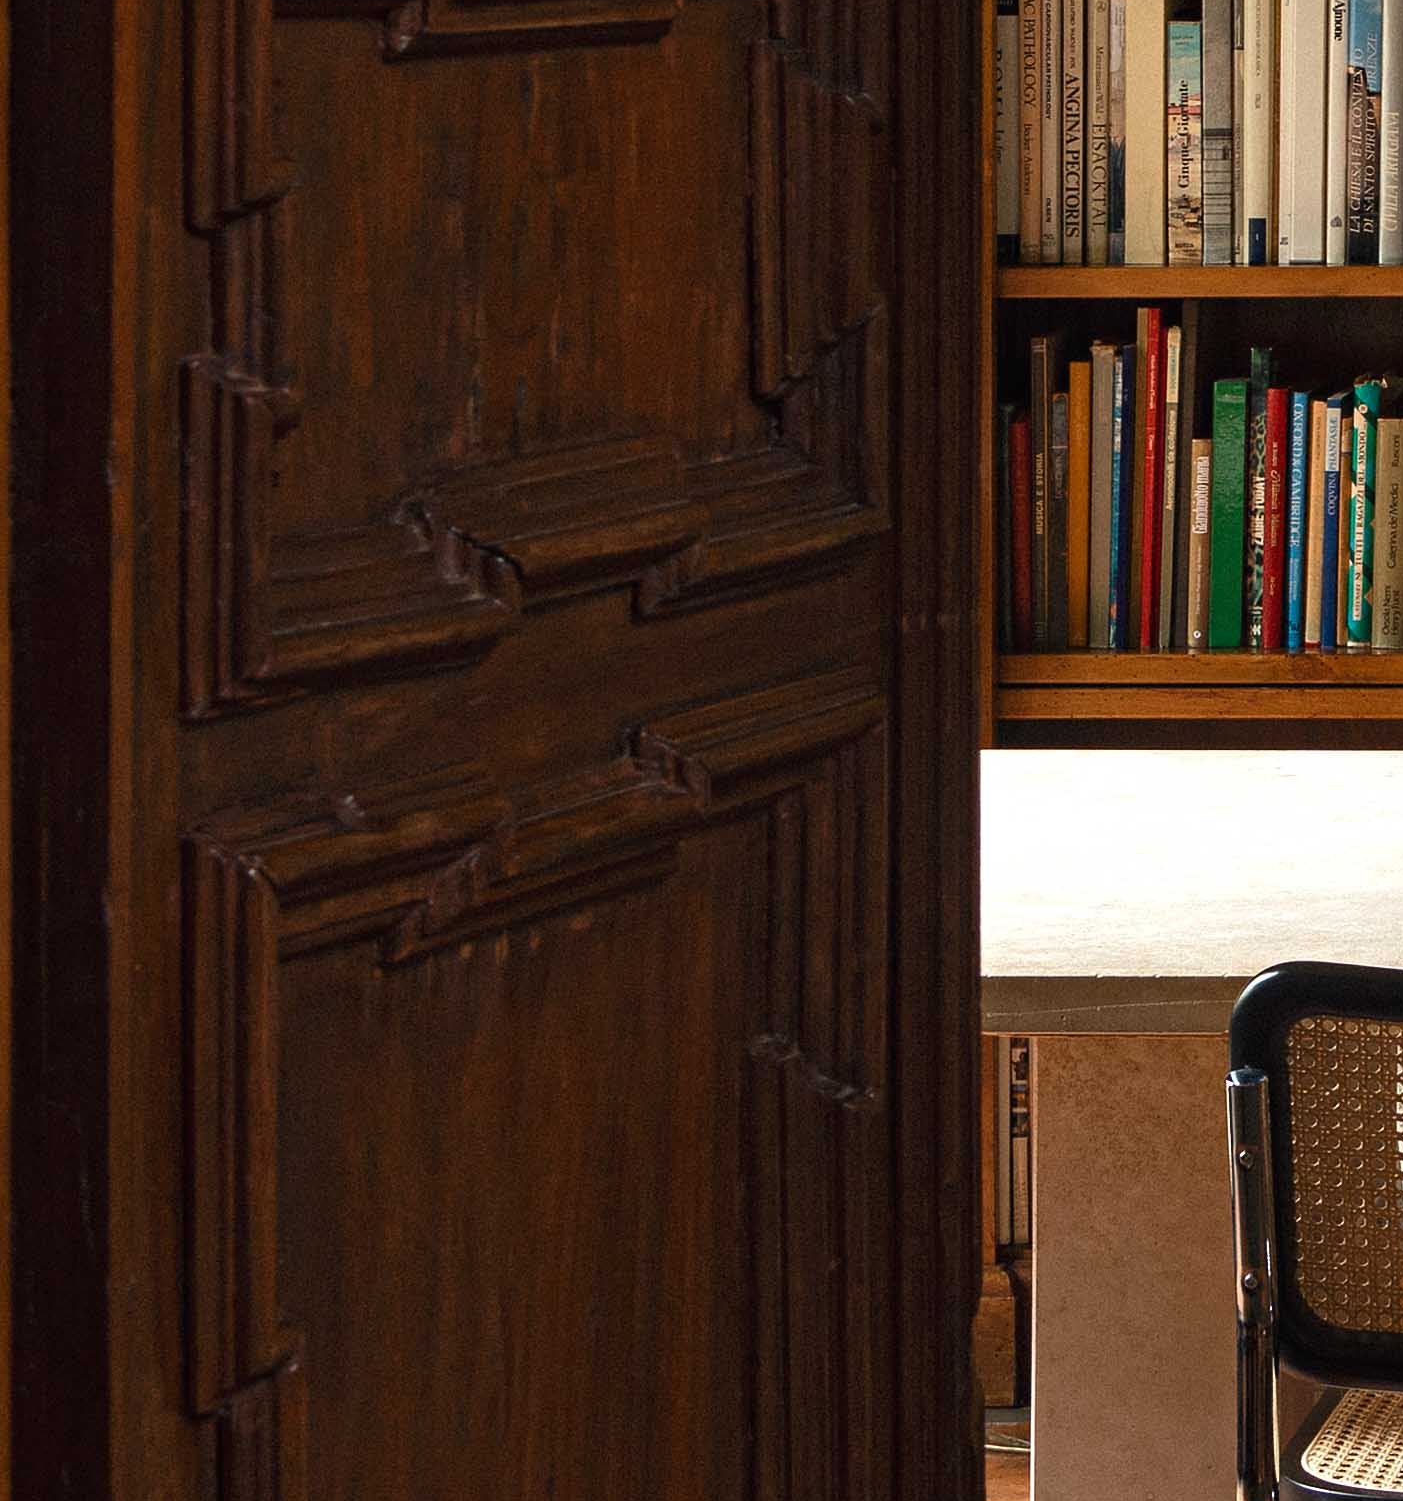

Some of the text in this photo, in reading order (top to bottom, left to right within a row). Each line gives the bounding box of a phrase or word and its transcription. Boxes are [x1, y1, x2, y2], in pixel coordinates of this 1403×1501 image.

[1332, 0, 1346, 41] Ajmone
[1023, 19, 1036, 107] PATHOLOGY
[1177, 81, 1190, 137] Giornate
[1065, 72, 1080, 238] ANGINA PECTORIS
[1091, 123, 1107, 233] EISACKTAL
[1177, 142, 1193, 188] Cinque
[1293, 403, 1305, 458] OXFORD
[1035, 453, 1044, 485] STORIA
[1191, 456, 1209, 484] mania
[1035, 501, 1044, 535] MUSICA
[1250, 475, 1265, 546] ZAIRE TODAY
[1290, 468, 1303, 547] CAMBRIDGE
